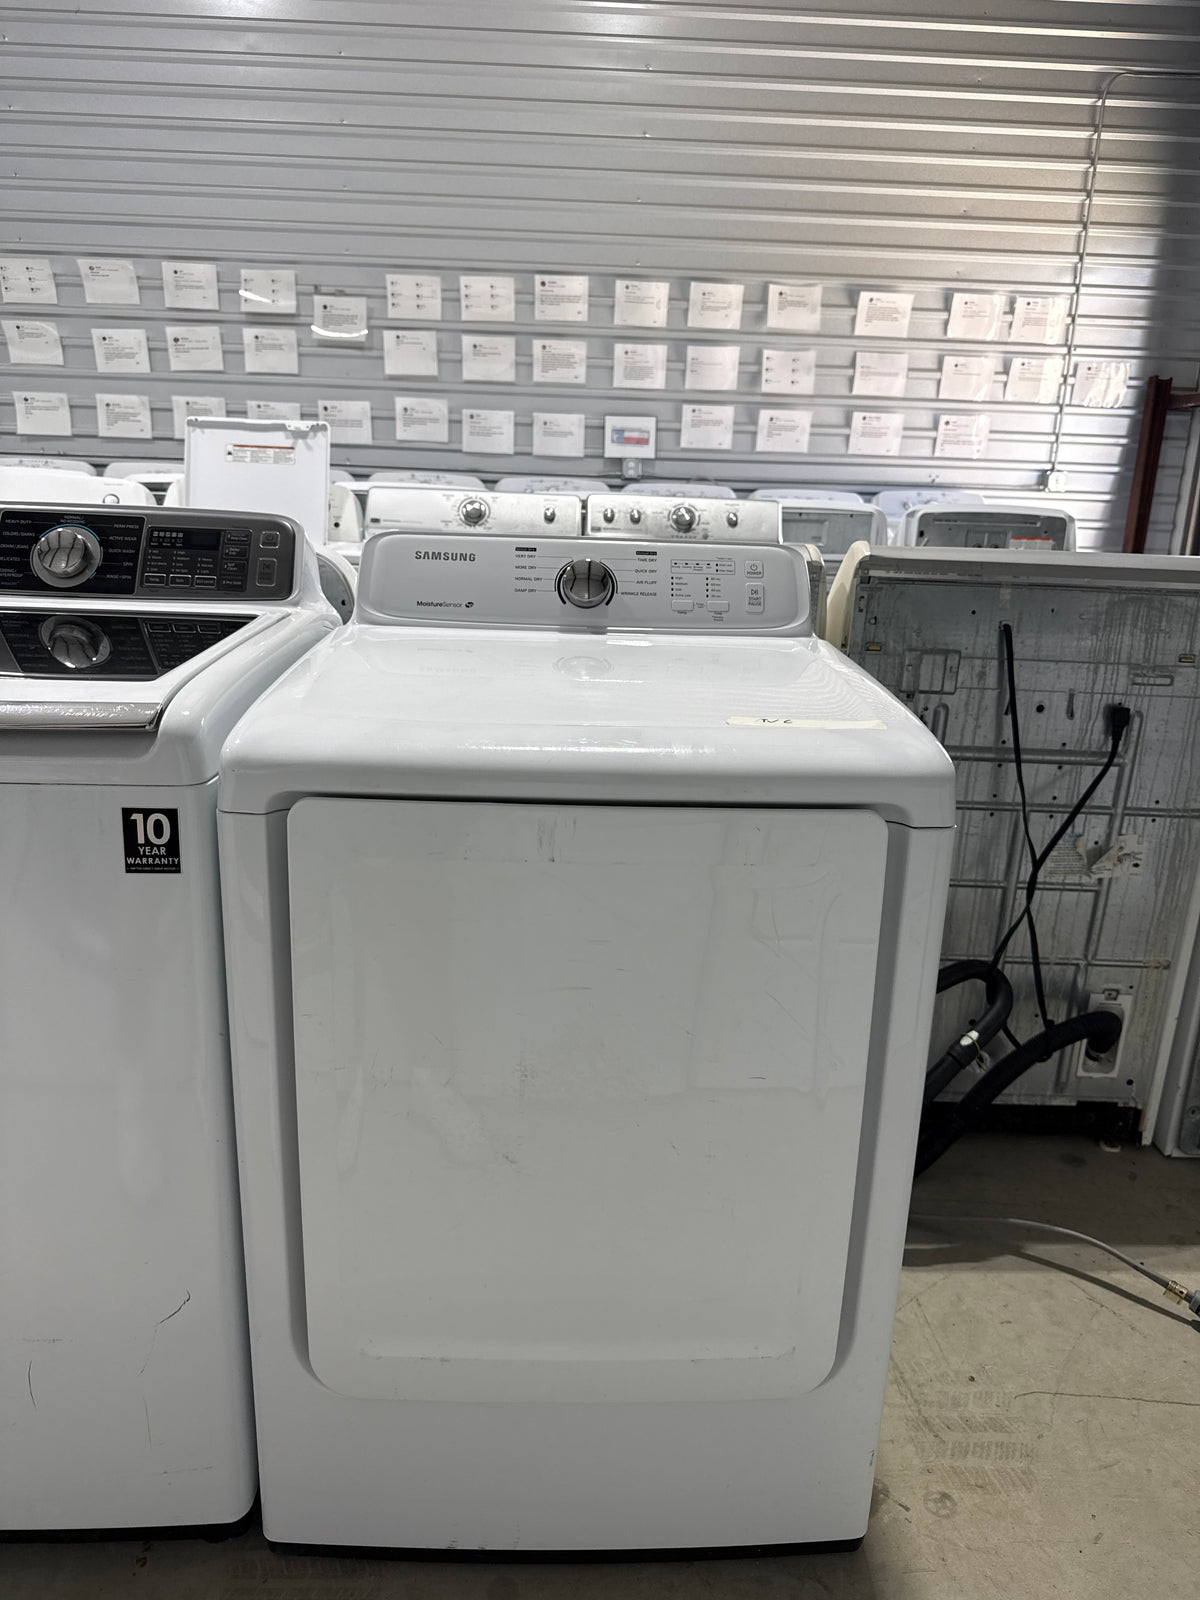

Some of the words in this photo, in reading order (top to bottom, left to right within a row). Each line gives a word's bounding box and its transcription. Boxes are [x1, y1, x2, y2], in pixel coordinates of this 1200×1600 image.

[415, 551, 476, 562] SAMSUNG
[416, 600, 462, 608] MoistureSensor
[130, 813, 171, 845] 10
[138, 846, 167, 855] YEAR
[126, 857, 179, 865] WARRANTY
